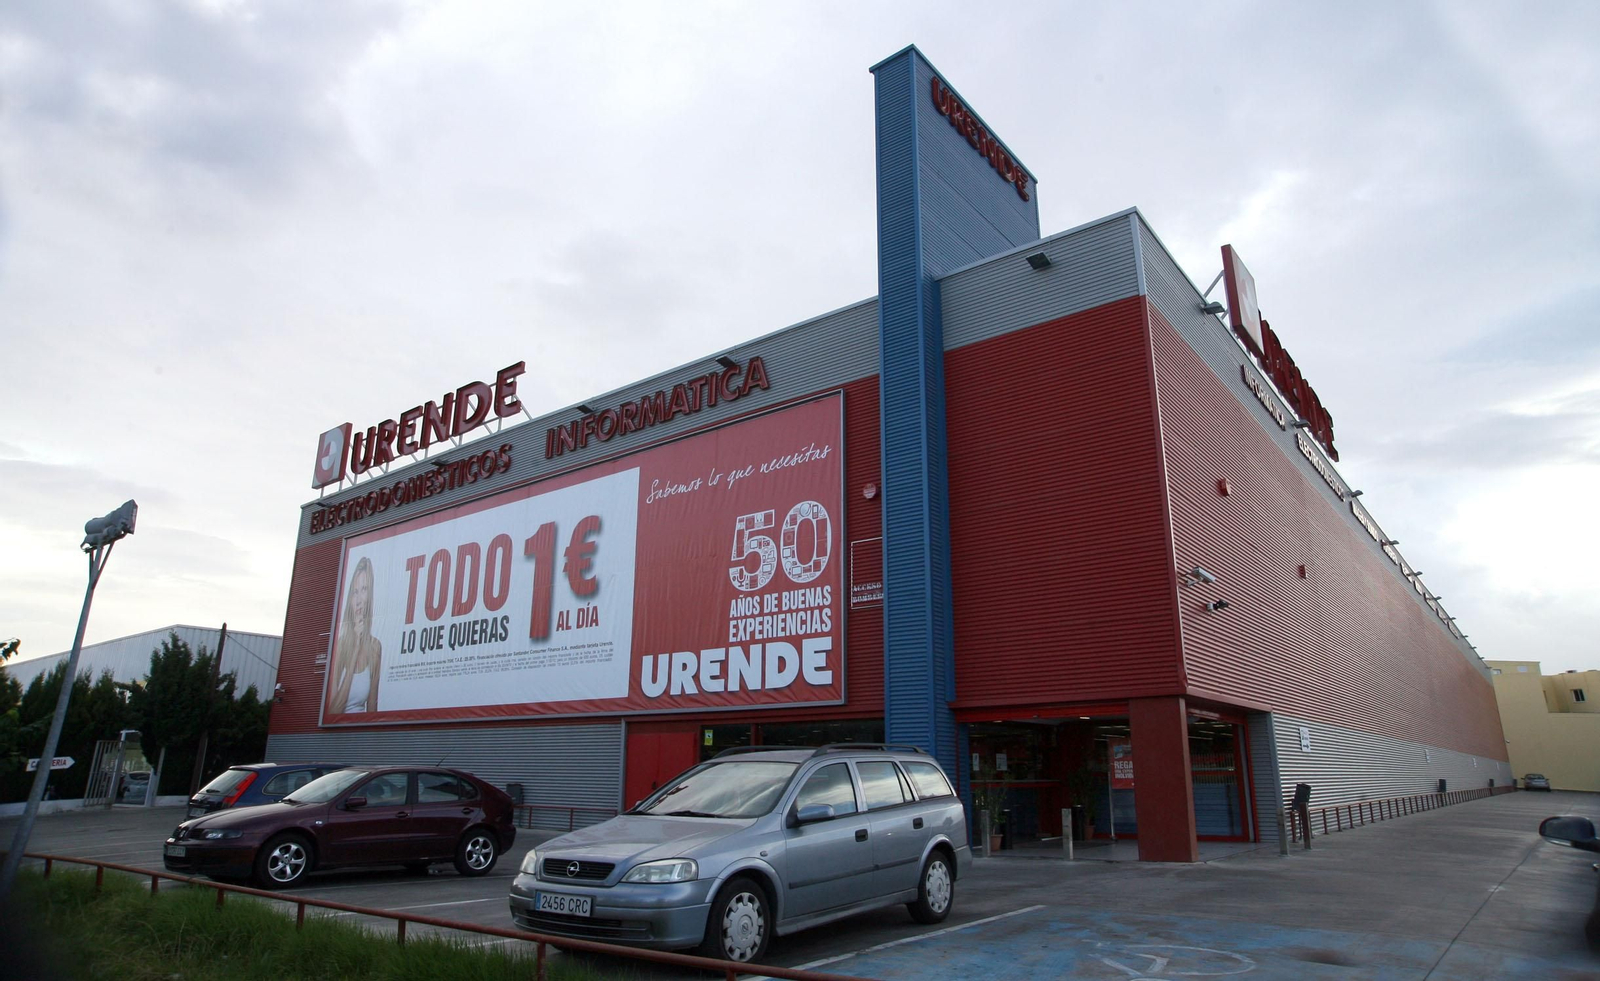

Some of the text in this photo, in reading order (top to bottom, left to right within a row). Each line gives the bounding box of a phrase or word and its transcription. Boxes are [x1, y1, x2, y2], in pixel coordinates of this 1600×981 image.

[931, 76, 1029, 202] URENDE
[351, 361, 526, 475] URENDE
[545, 356, 770, 459] INFORMATICA
[310, 443, 513, 535] ELECTRODOMESTICOS
[646, 443, 832, 504] Sabemos lo que necesitas
[728, 500, 832, 592] 50
[405, 534, 513, 624] TODO
[729, 585, 832, 618] AÑOS DE BUENAS
[400, 615, 510, 654] LO QUE QUIERAS
[556, 602, 599, 632] AL DÍA
[729, 608, 832, 643] EXPERIENCIAS
[640, 636, 833, 698] URENDE
[541, 895, 588, 914] 2456 CRC
